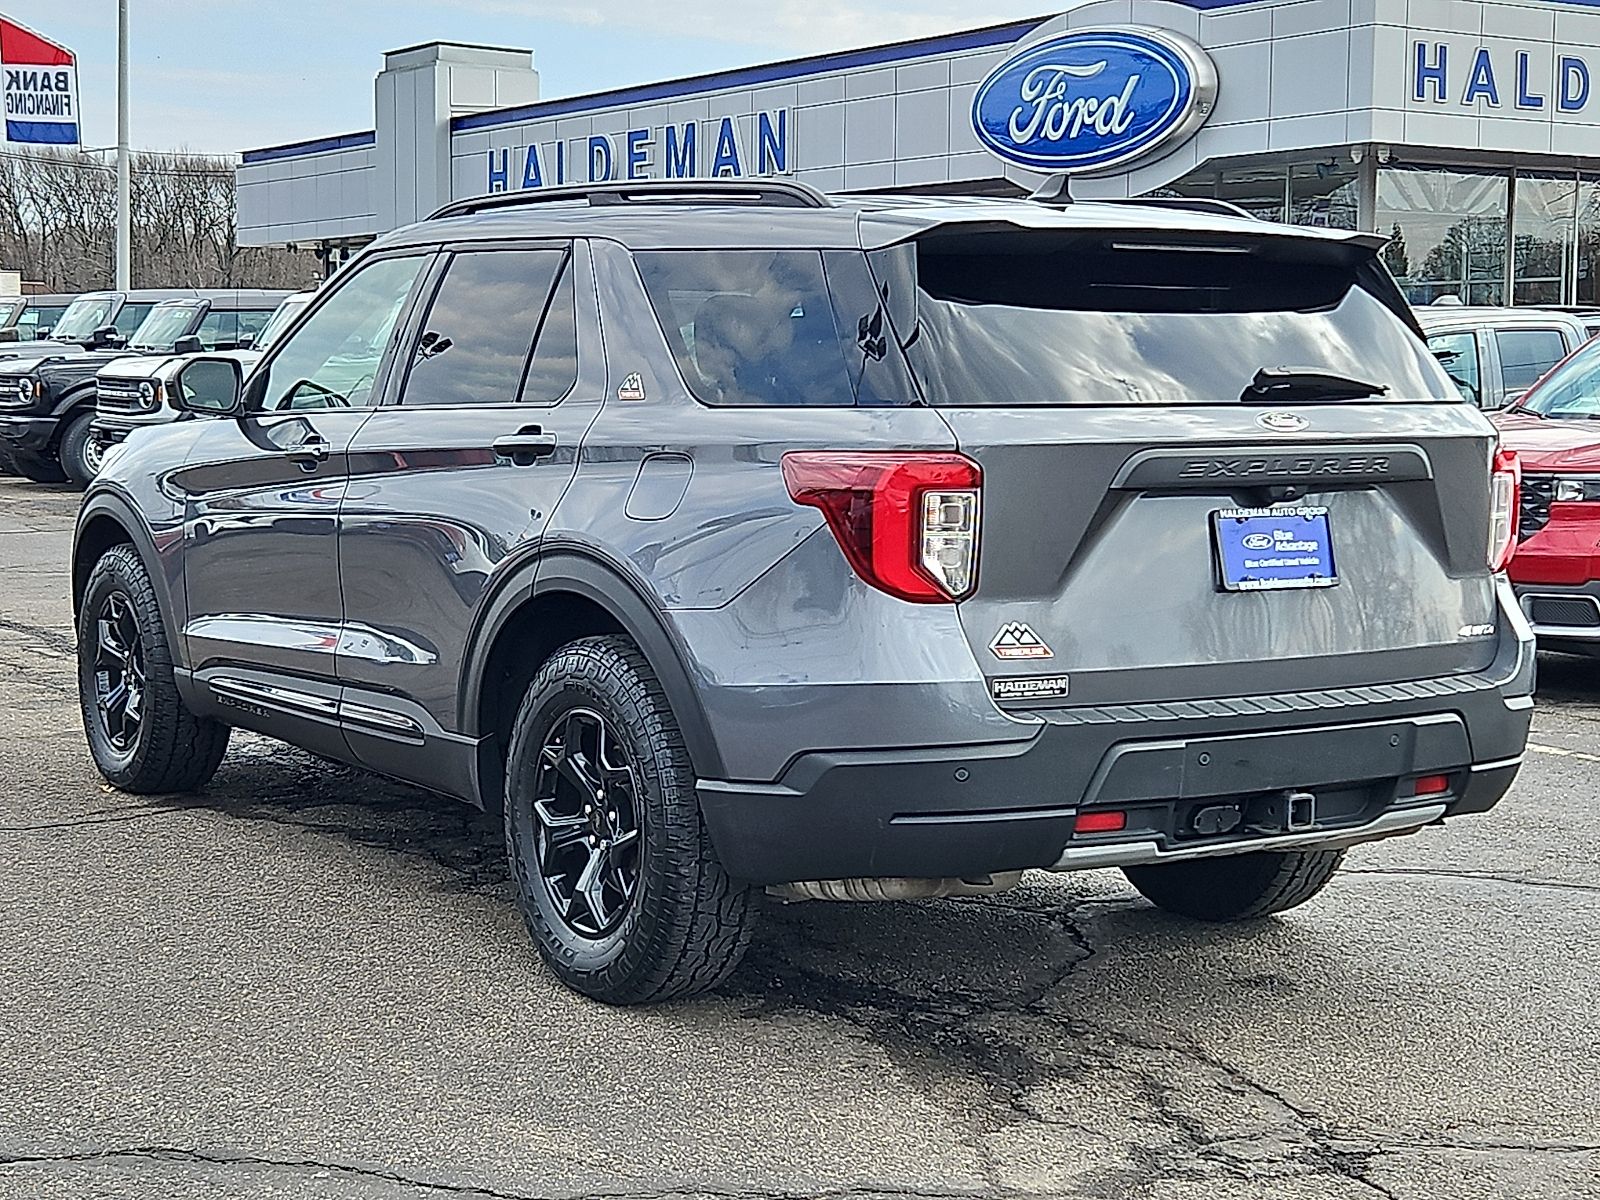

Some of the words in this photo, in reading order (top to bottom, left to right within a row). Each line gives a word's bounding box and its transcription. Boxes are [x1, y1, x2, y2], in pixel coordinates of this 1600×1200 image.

[1009, 60, 1141, 144] Ford
[1412, 40, 1592, 114] HALD
[487, 107, 789, 194] HALDEMAN
[1178, 456, 1391, 478] EXPLORER
[1271, 506, 1296, 517] AUTO
